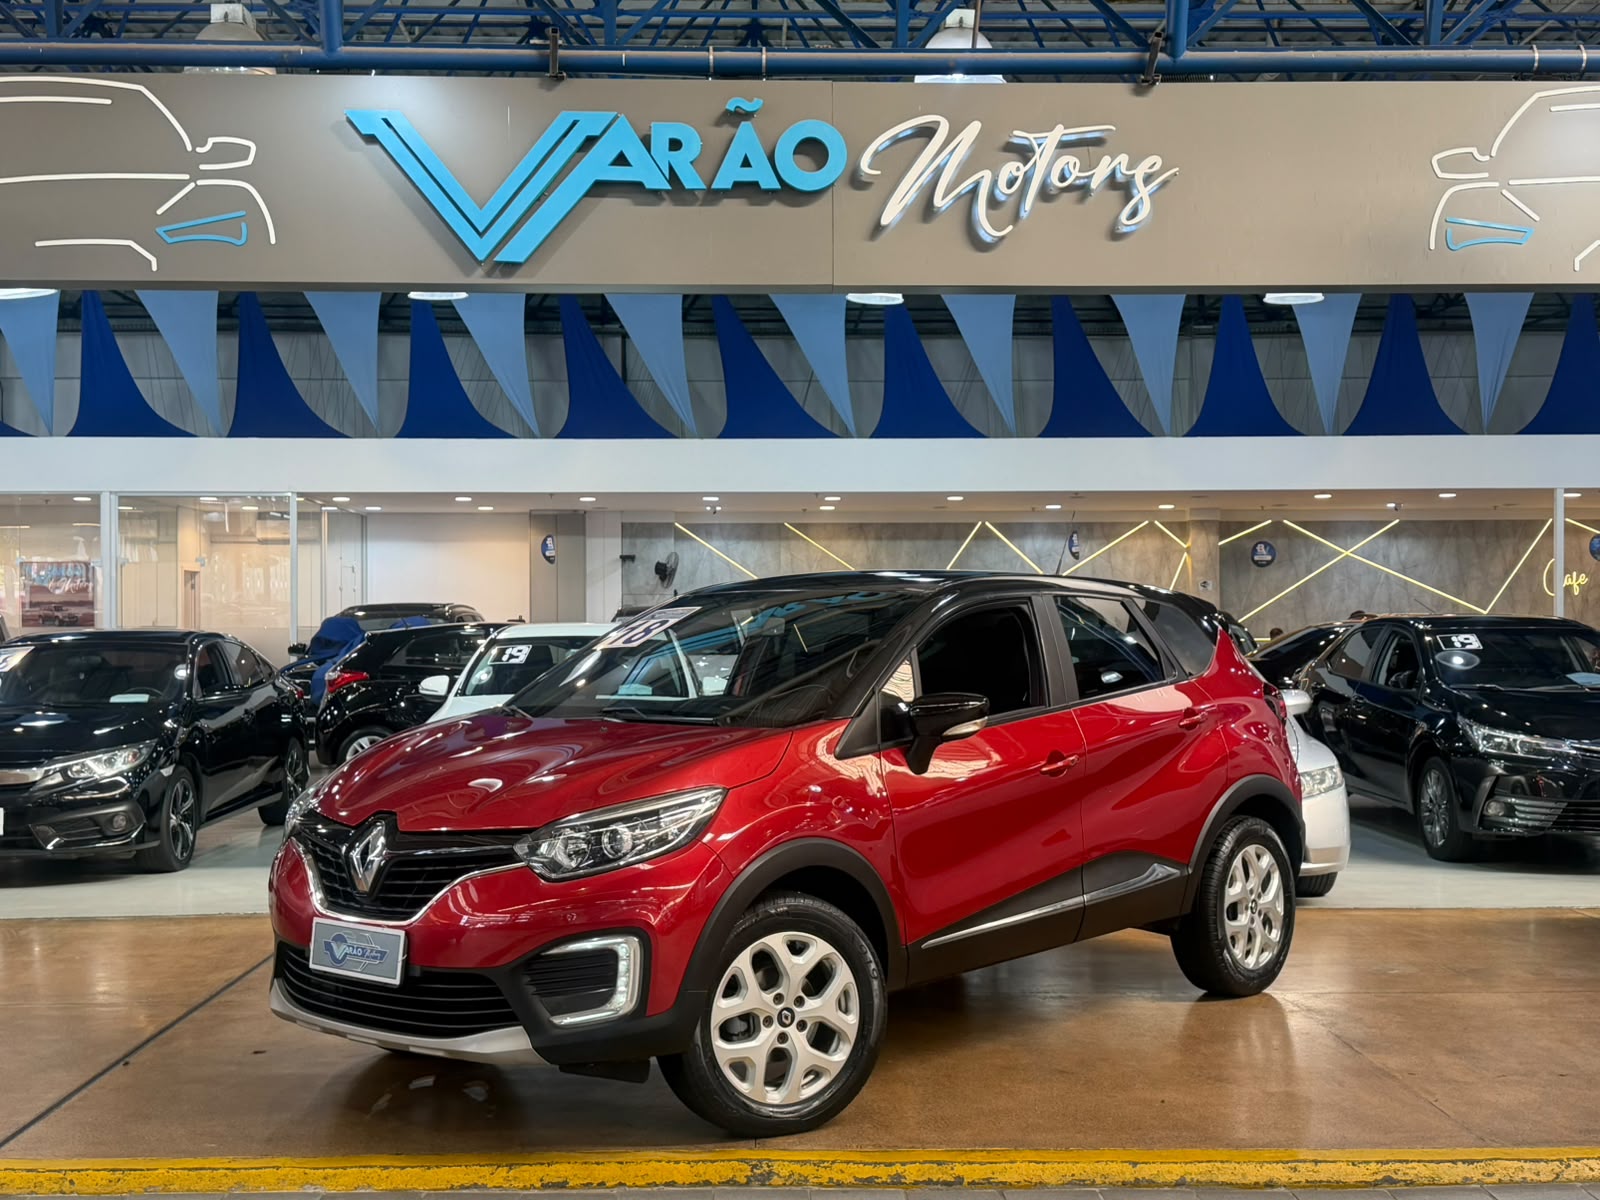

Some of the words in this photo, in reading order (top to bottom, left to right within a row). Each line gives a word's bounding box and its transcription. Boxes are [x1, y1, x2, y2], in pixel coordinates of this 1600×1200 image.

[344, 97, 848, 263] VARÃO
[859, 114, 1180, 238] Motors
[607, 620, 670, 645] 18
[1451, 634, 1479, 649] 19
[502, 646, 529, 663] 19
